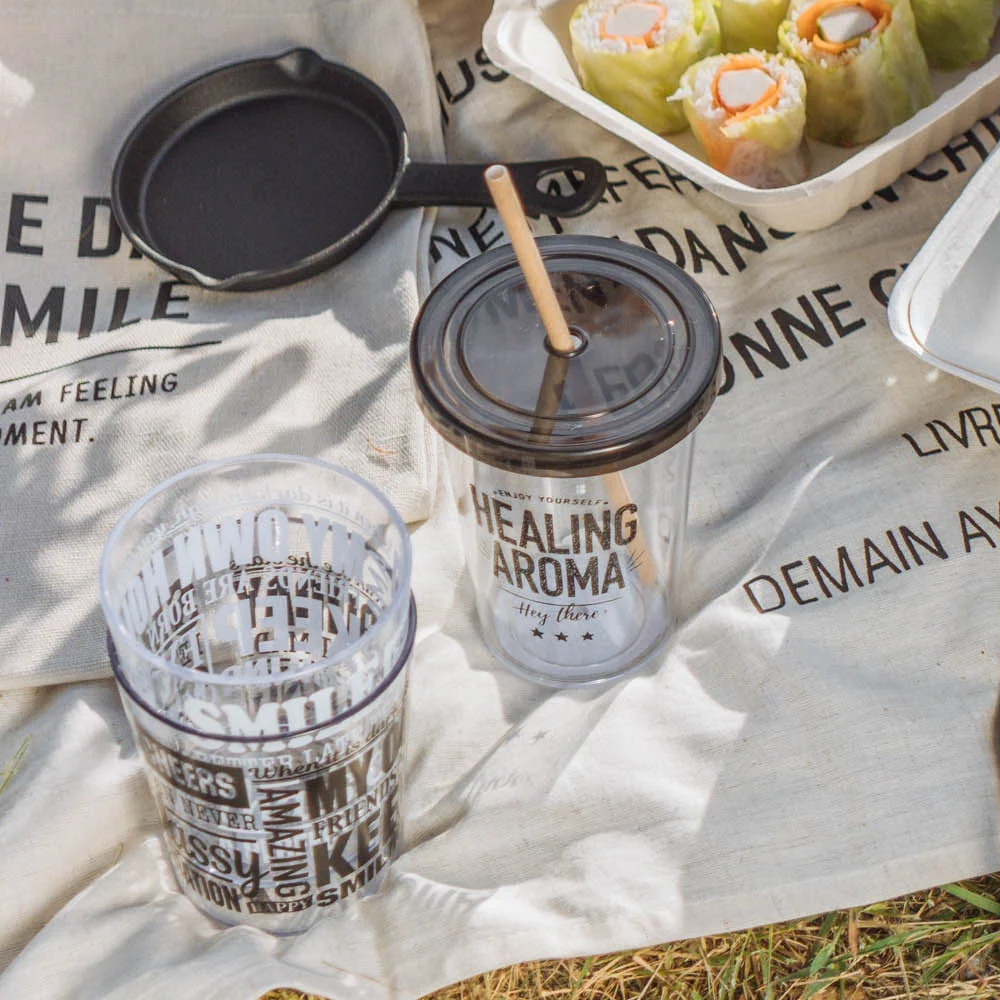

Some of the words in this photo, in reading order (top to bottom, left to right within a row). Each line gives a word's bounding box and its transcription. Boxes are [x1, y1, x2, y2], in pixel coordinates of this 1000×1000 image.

[6, 193, 49, 256] E
[634, 210, 796, 277] DAN
[3, 389, 42, 415] AM
[60, 372, 179, 403] FEELING
[0, 417, 95, 447] MENT.
[469, 483, 639, 556] HEALING
[497, 488, 533, 502] ENJOY
[537, 495, 603, 507] YOURSELF
[492, 540, 626, 598] AROMA
[742, 525, 948, 615] DEMAIN
[512, 601, 552, 626] Hey
[555, 602, 603, 623] there
[181, 797, 259, 832] NEVER
[312, 773, 397, 840] FRIENDS
[257, 787, 311, 899] AMAZING
